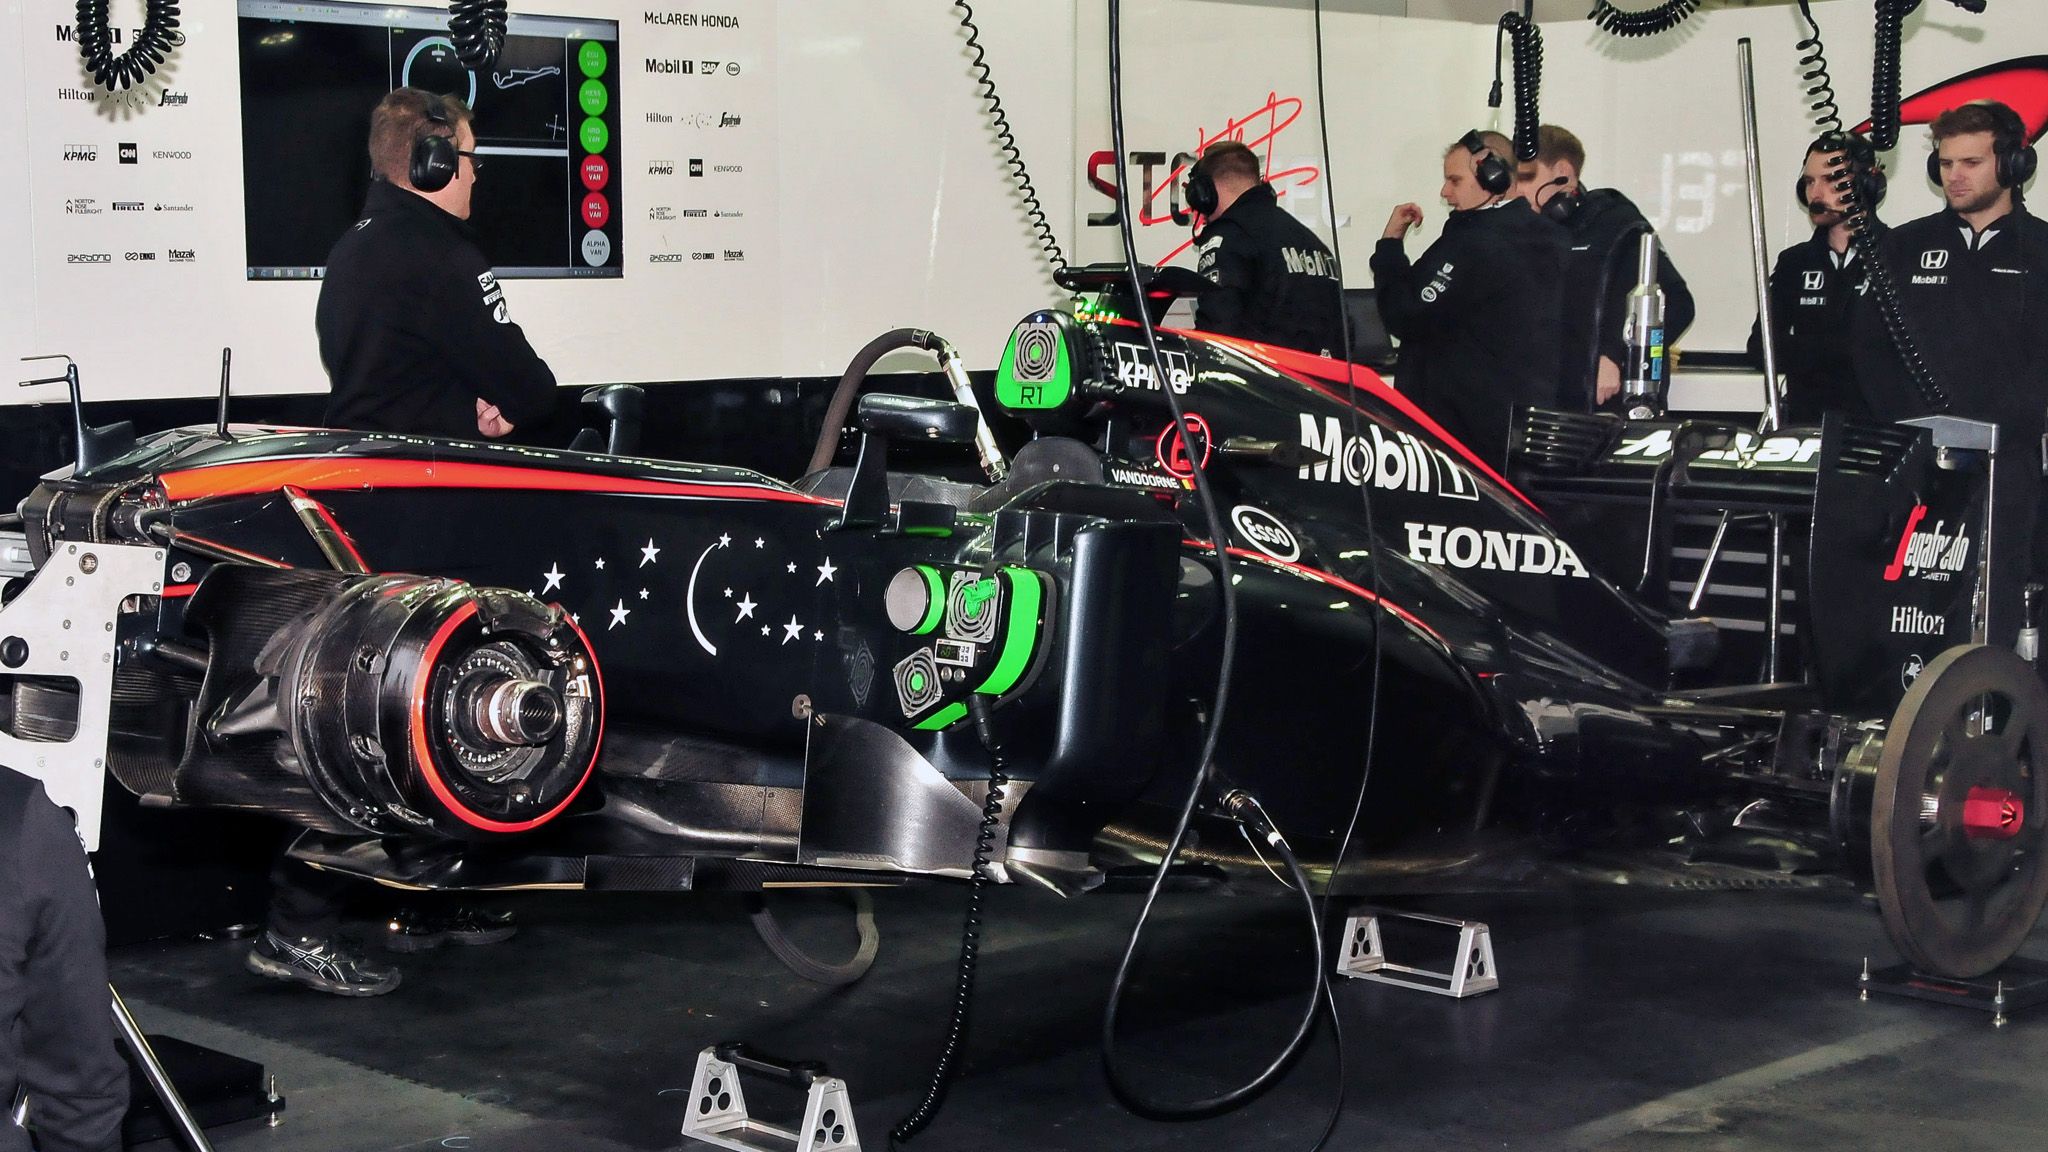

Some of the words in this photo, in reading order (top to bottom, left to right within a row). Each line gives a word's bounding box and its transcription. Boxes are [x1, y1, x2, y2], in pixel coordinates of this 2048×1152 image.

[644, 11, 698, 26] McLAREN
[701, 15, 739, 28] HONDA
[645, 59, 680, 73] Mobil
[701, 62, 718, 74] SAP
[58, 88, 95, 101] Hilton
[646, 113, 673, 123] Hilton
[63, 151, 97, 162] KPMG
[152, 151, 192, 160] KENWOOD
[648, 166, 673, 175] KPMG
[713, 165, 743, 173] KENWOOD
[112, 202, 145, 211] PIRELLI
[683, 210, 707, 218] PIRELLI
[168, 249, 195, 258] Mazak
[723, 249, 744, 258] Mazak
[1911, 275, 1938, 285] Mobil
[1020, 386, 1042, 405] R1
[1299, 412, 1430, 493] Mobil
[1111, 468, 1180, 489] VANDOORNE
[1883, 505, 1969, 581] Segafredo
[1404, 521, 1590, 578] HONDA
[1890, 606, 1945, 635] Hilton
